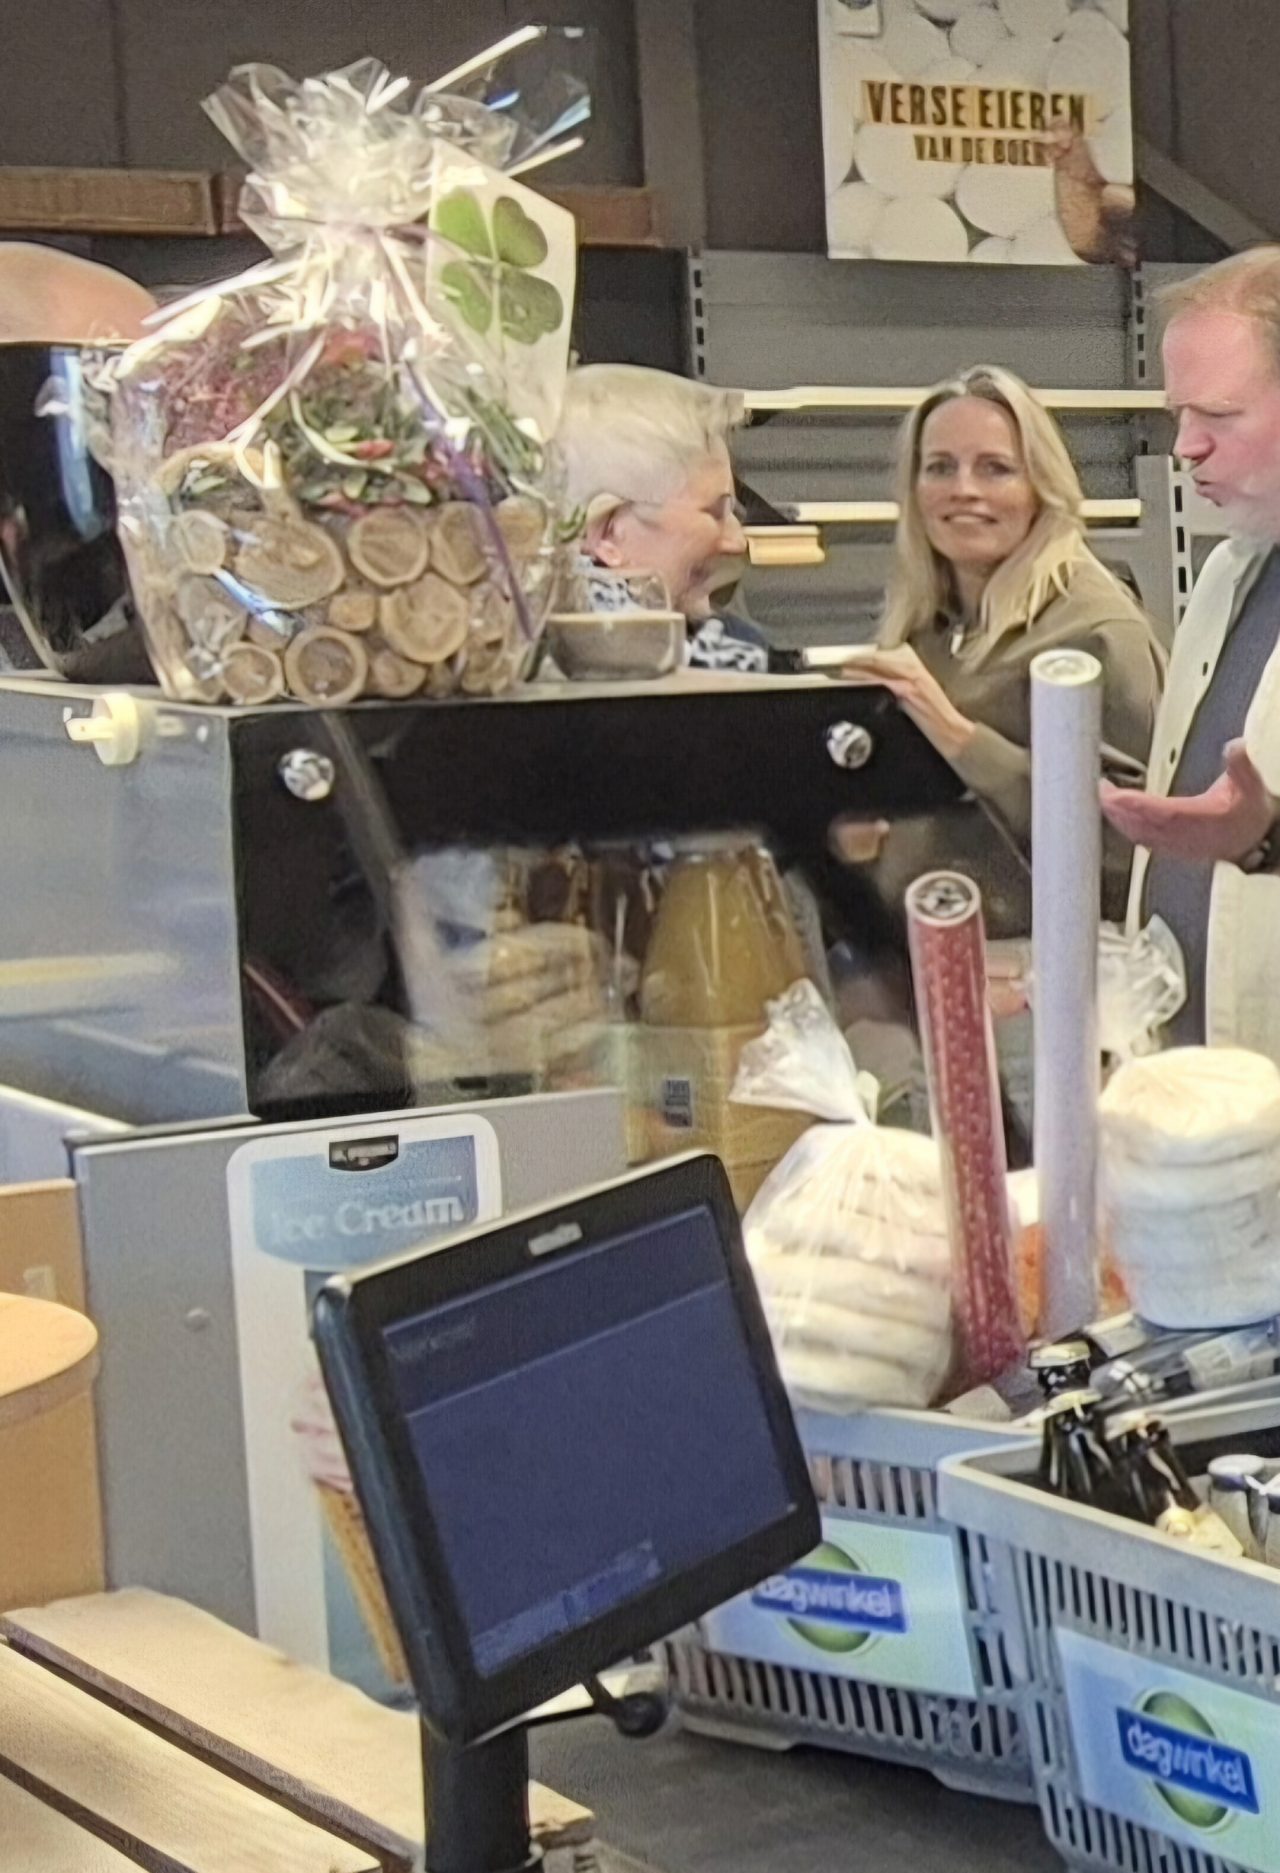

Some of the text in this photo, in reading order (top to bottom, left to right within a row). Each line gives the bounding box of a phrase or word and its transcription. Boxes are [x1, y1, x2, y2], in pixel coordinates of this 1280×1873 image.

[866, 80, 1084, 135] VERSE EIEREN
[913, 134, 951, 162] VAN
[961, 137, 985, 164] DE
[269, 1196, 465, 1246] Ice Cream
[1127, 1720, 1249, 1797] dagwinkel
